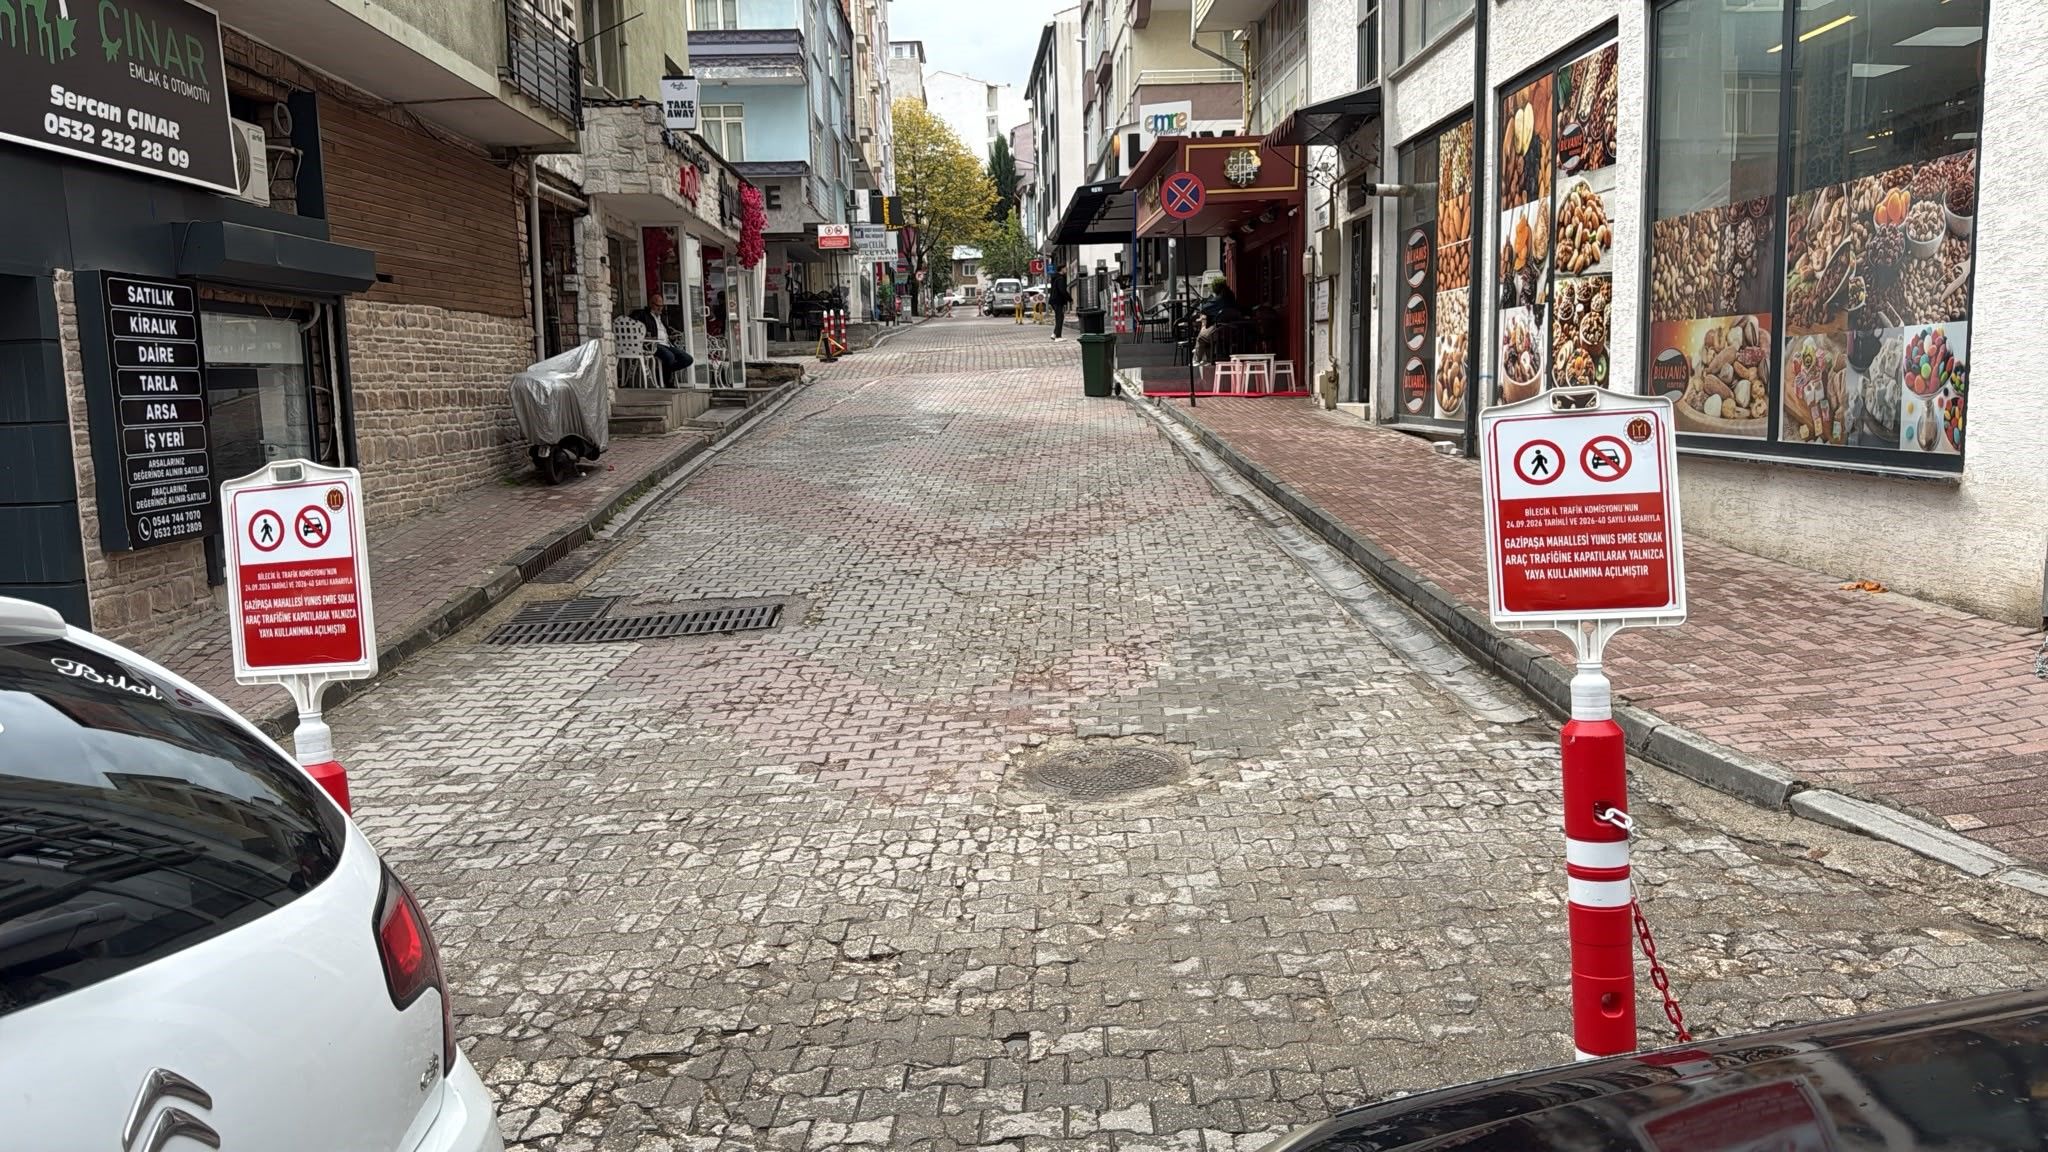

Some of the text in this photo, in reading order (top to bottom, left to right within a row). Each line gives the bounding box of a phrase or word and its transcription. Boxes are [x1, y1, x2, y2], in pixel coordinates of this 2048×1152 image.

[99, 0, 208, 85] ÇINAR
[128, 62, 210, 105] EMLAK & OTOMOTİV
[50, 84, 180, 140] Sercan ÇINAR
[666, 100, 694, 109] TAKE
[667, 110, 694, 118] AWAY
[1144, 112, 1188, 134] emre
[44, 112, 190, 169] 0532 232 28 09
[127, 285, 175, 306] SATILIK
[130, 313, 178, 335] KİRALIK
[138, 342, 174, 363] DAİRE
[139, 375, 178, 391] TARLA
[146, 404, 178, 420] ARSA
[144, 428, 184, 452] İŞ YERİ
[148, 457, 185, 468] ARSALARINIZ
[133, 465, 204, 481] DEĞERİNDE ALINIR SATILIR
[152, 484, 188, 497] ARAÇLARINIZ
[136, 492, 206, 509] DEĞERİNDE ALINIR SATILIR
[152, 510, 201, 526] 0544 744 7070
[1524, 504, 1639, 516] BİLECİK İL TRAFİK KOMİSYONU'NUN
[1544, 517, 1568, 526] TARİHLİ
[1569, 517, 1578, 525] VE
[1607, 515, 1626, 524] SAYILI
[1628, 514, 1661, 523] KARARIYLA
[154, 521, 202, 538] 0532 232 2809
[1504, 532, 1663, 550] GAZİPAŞA MAHALLESİ YUNUS EMRE SOKAK
[1505, 548, 1664, 567] ARAÇ TRAFİĞİNE KAPATILARAK YALNIZCA
[1525, 565, 1649, 581] YAYA KULLANIMINA AÇILMIŞTIR
[244, 598, 272, 611] GAZİPAŞA
[273, 595, 303, 608] MAHALLESİ
[322, 595, 337, 604] EMRE
[338, 594, 355, 603] SOKAK
[246, 609, 357, 626] ARAÇ TRAFİĞİNE KAPATILARAK YALNIZCA
[259, 624, 346, 638] YAYA KULLANIMINA AÇILMIŞTIR
[50, 658, 162, 700] Bilal
